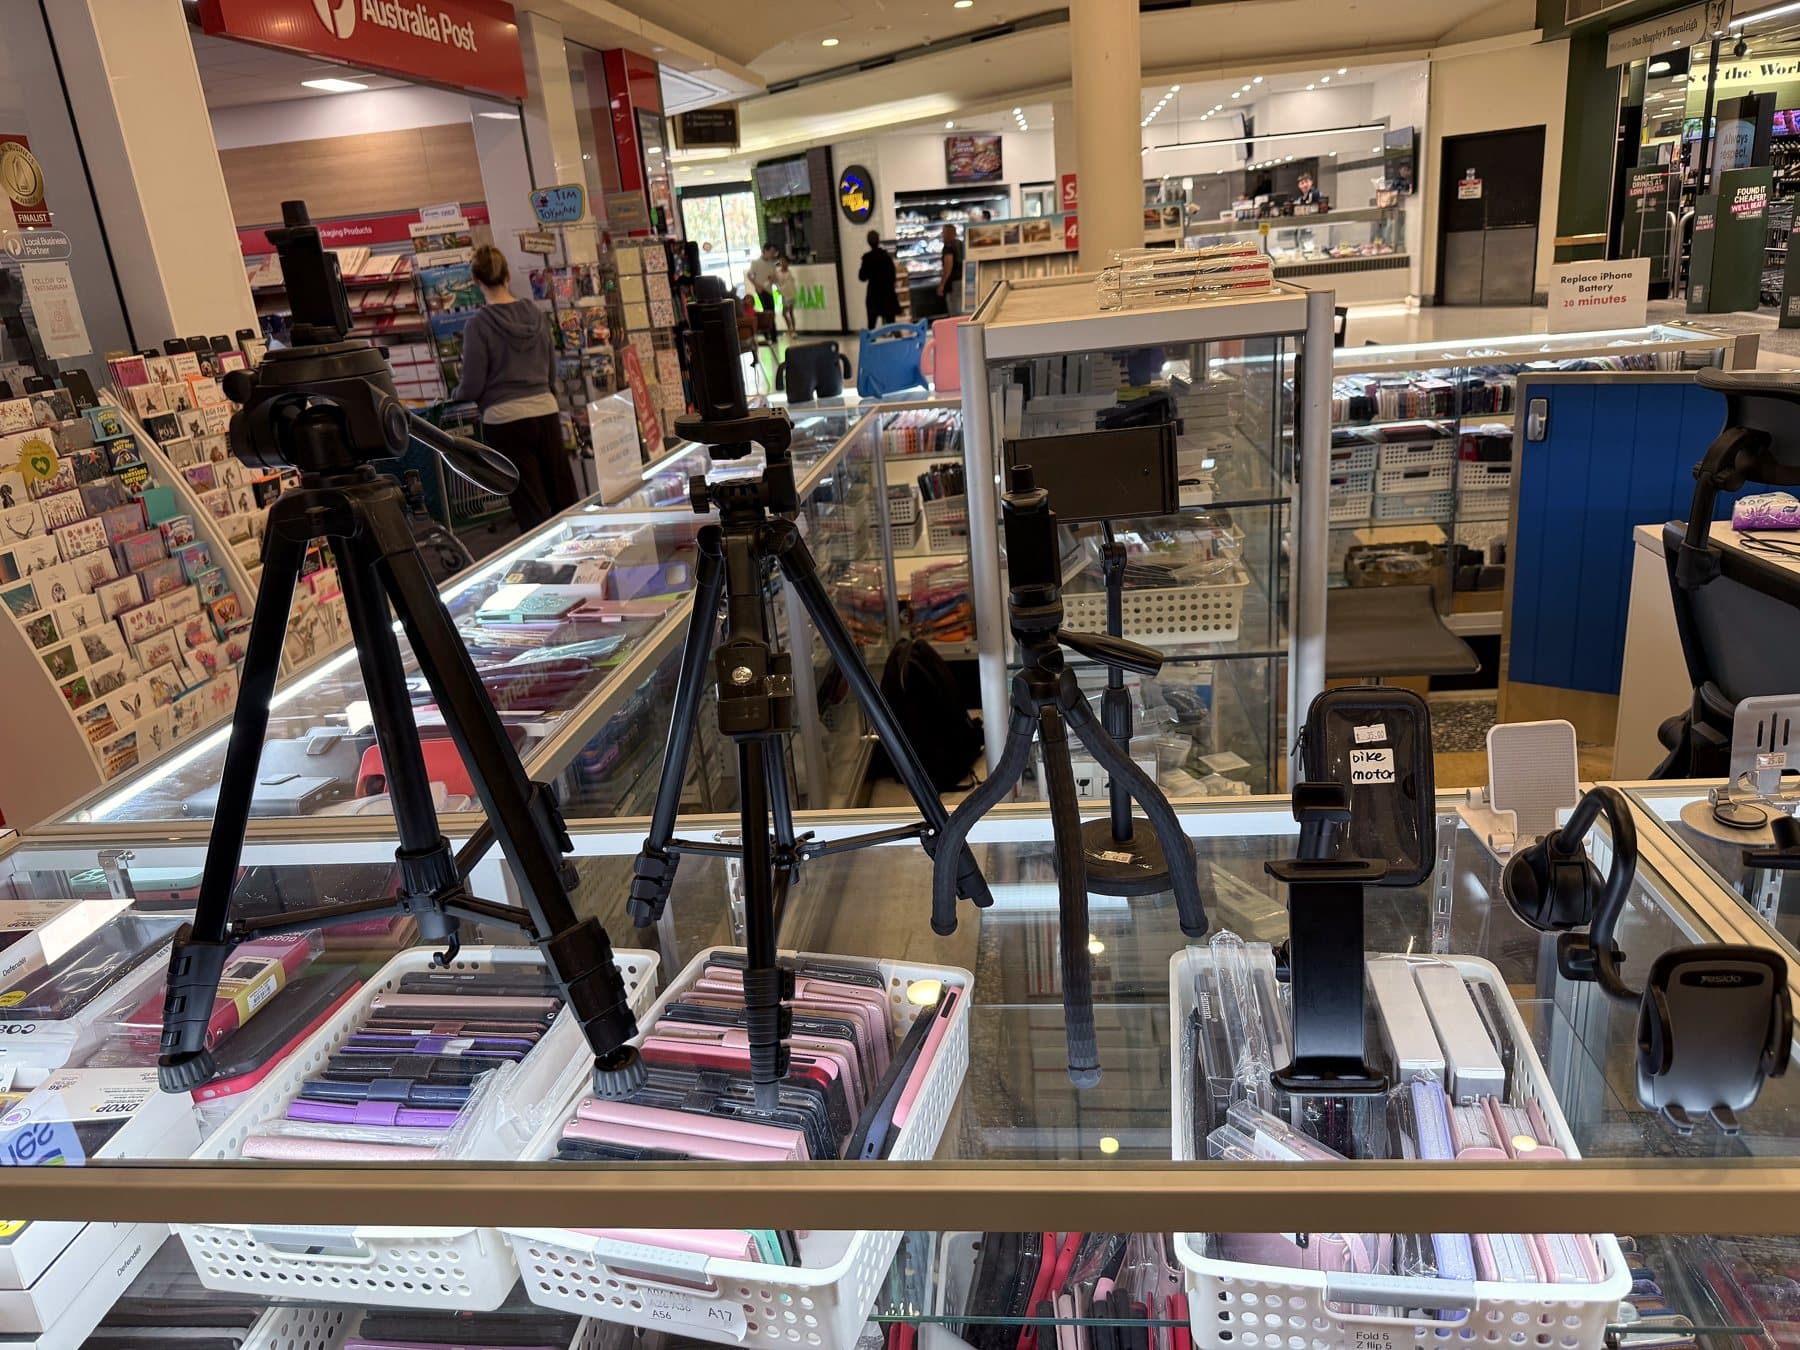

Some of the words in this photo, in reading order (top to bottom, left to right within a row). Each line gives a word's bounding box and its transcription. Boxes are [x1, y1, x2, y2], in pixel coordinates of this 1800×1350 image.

[361, 0, 441, 42] Australia
[439, 13, 478, 52] Post
[1642, 29, 1666, 46] Murphy's
[1667, 18, 1698, 36] Thornleigh
[1725, 66, 1751, 80] the
[1760, 61, 1800, 77] Worl
[553, 189, 577, 201] TIM
[1737, 186, 1759, 196] FOUND
[1734, 193, 1767, 203] CHEAPER?
[539, 206, 577, 219] TOYMAN
[1731, 202, 1750, 212] WE'LL
[18, 213, 47, 223] FINALIST
[344, 226, 373, 236] Products
[23, 237, 41, 246] Local
[40, 235, 67, 246] Business
[26, 247, 50, 255] Partner
[1560, 274, 1598, 285] Replace
[1600, 271, 1633, 281] iPhone
[1578, 284, 1614, 293] Battery
[1564, 299, 1575, 307] 20
[1578, 294, 1627, 306] minutes
[1352, 751, 1387, 764] bike
[1352, 768, 1396, 781] motor
[2, 956, 27, 977] Defender
[0, 1024, 36, 1035] cas
[116, 1244, 142, 1277] Defender
[652, 1309, 672, 1320] A56
[708, 1307, 732, 1322] A17
[1356, 1331, 1379, 1340] Fold
[1366, 1341, 1382, 1350] flip
